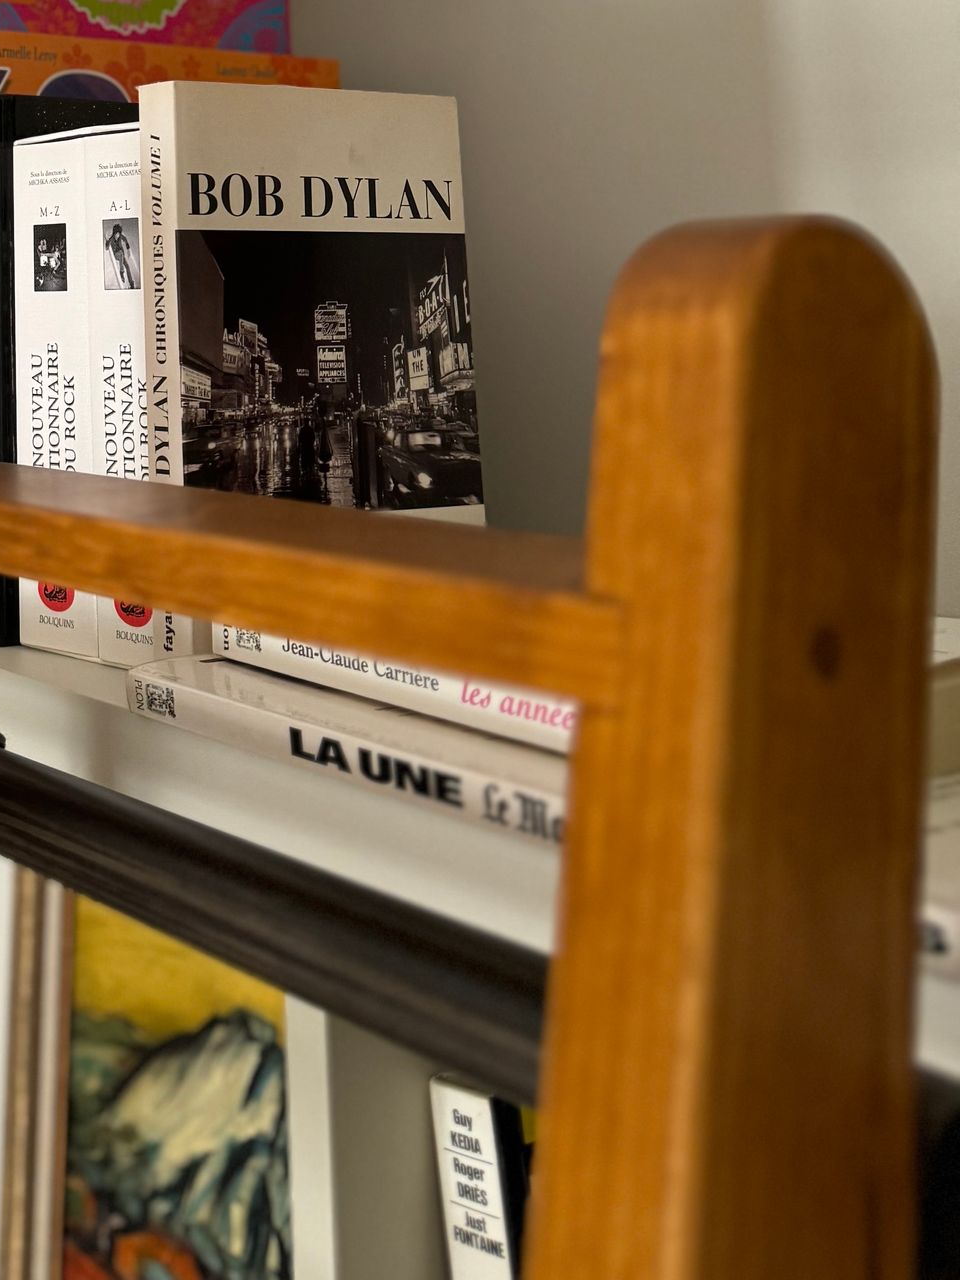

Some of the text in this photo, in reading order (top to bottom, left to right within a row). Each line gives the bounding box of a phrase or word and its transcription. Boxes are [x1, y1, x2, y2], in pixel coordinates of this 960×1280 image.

[96, 171, 118, 179] MICHKA
[113, 160, 132, 169] direction
[150, 146, 163, 227] VOLUME
[187, 172, 453, 221] BOB DYLAN
[153, 233, 168, 365] CHRONIQUES
[412, 360, 424, 372] THE
[31, 353, 44, 467] NOUVEAU
[63, 375, 76, 441] ROCK
[102, 355, 119, 476] NOUVEAU
[152, 374, 171, 477] DYLAN
[39, 614, 75, 629] BOUQUINS
[116, 630, 153, 645] BOUQUINS
[163, 610, 176, 652] faya
[282, 637, 369, 673] Jean-Claude
[461, 679, 491, 709] les
[134, 679, 145, 711] PLON
[289, 726, 353, 774] LA
[358, 747, 464, 808] UNE
[482, 782, 511, 827] Le
[452, 1108, 472, 1131] Guy
[450, 1130, 482, 1155] KEDIA
[453, 1157, 484, 1181] Roger
[457, 1182, 488, 1207] DRIÈS
[465, 1211, 487, 1233] Just
[453, 1225, 505, 1260] FONTAINE
